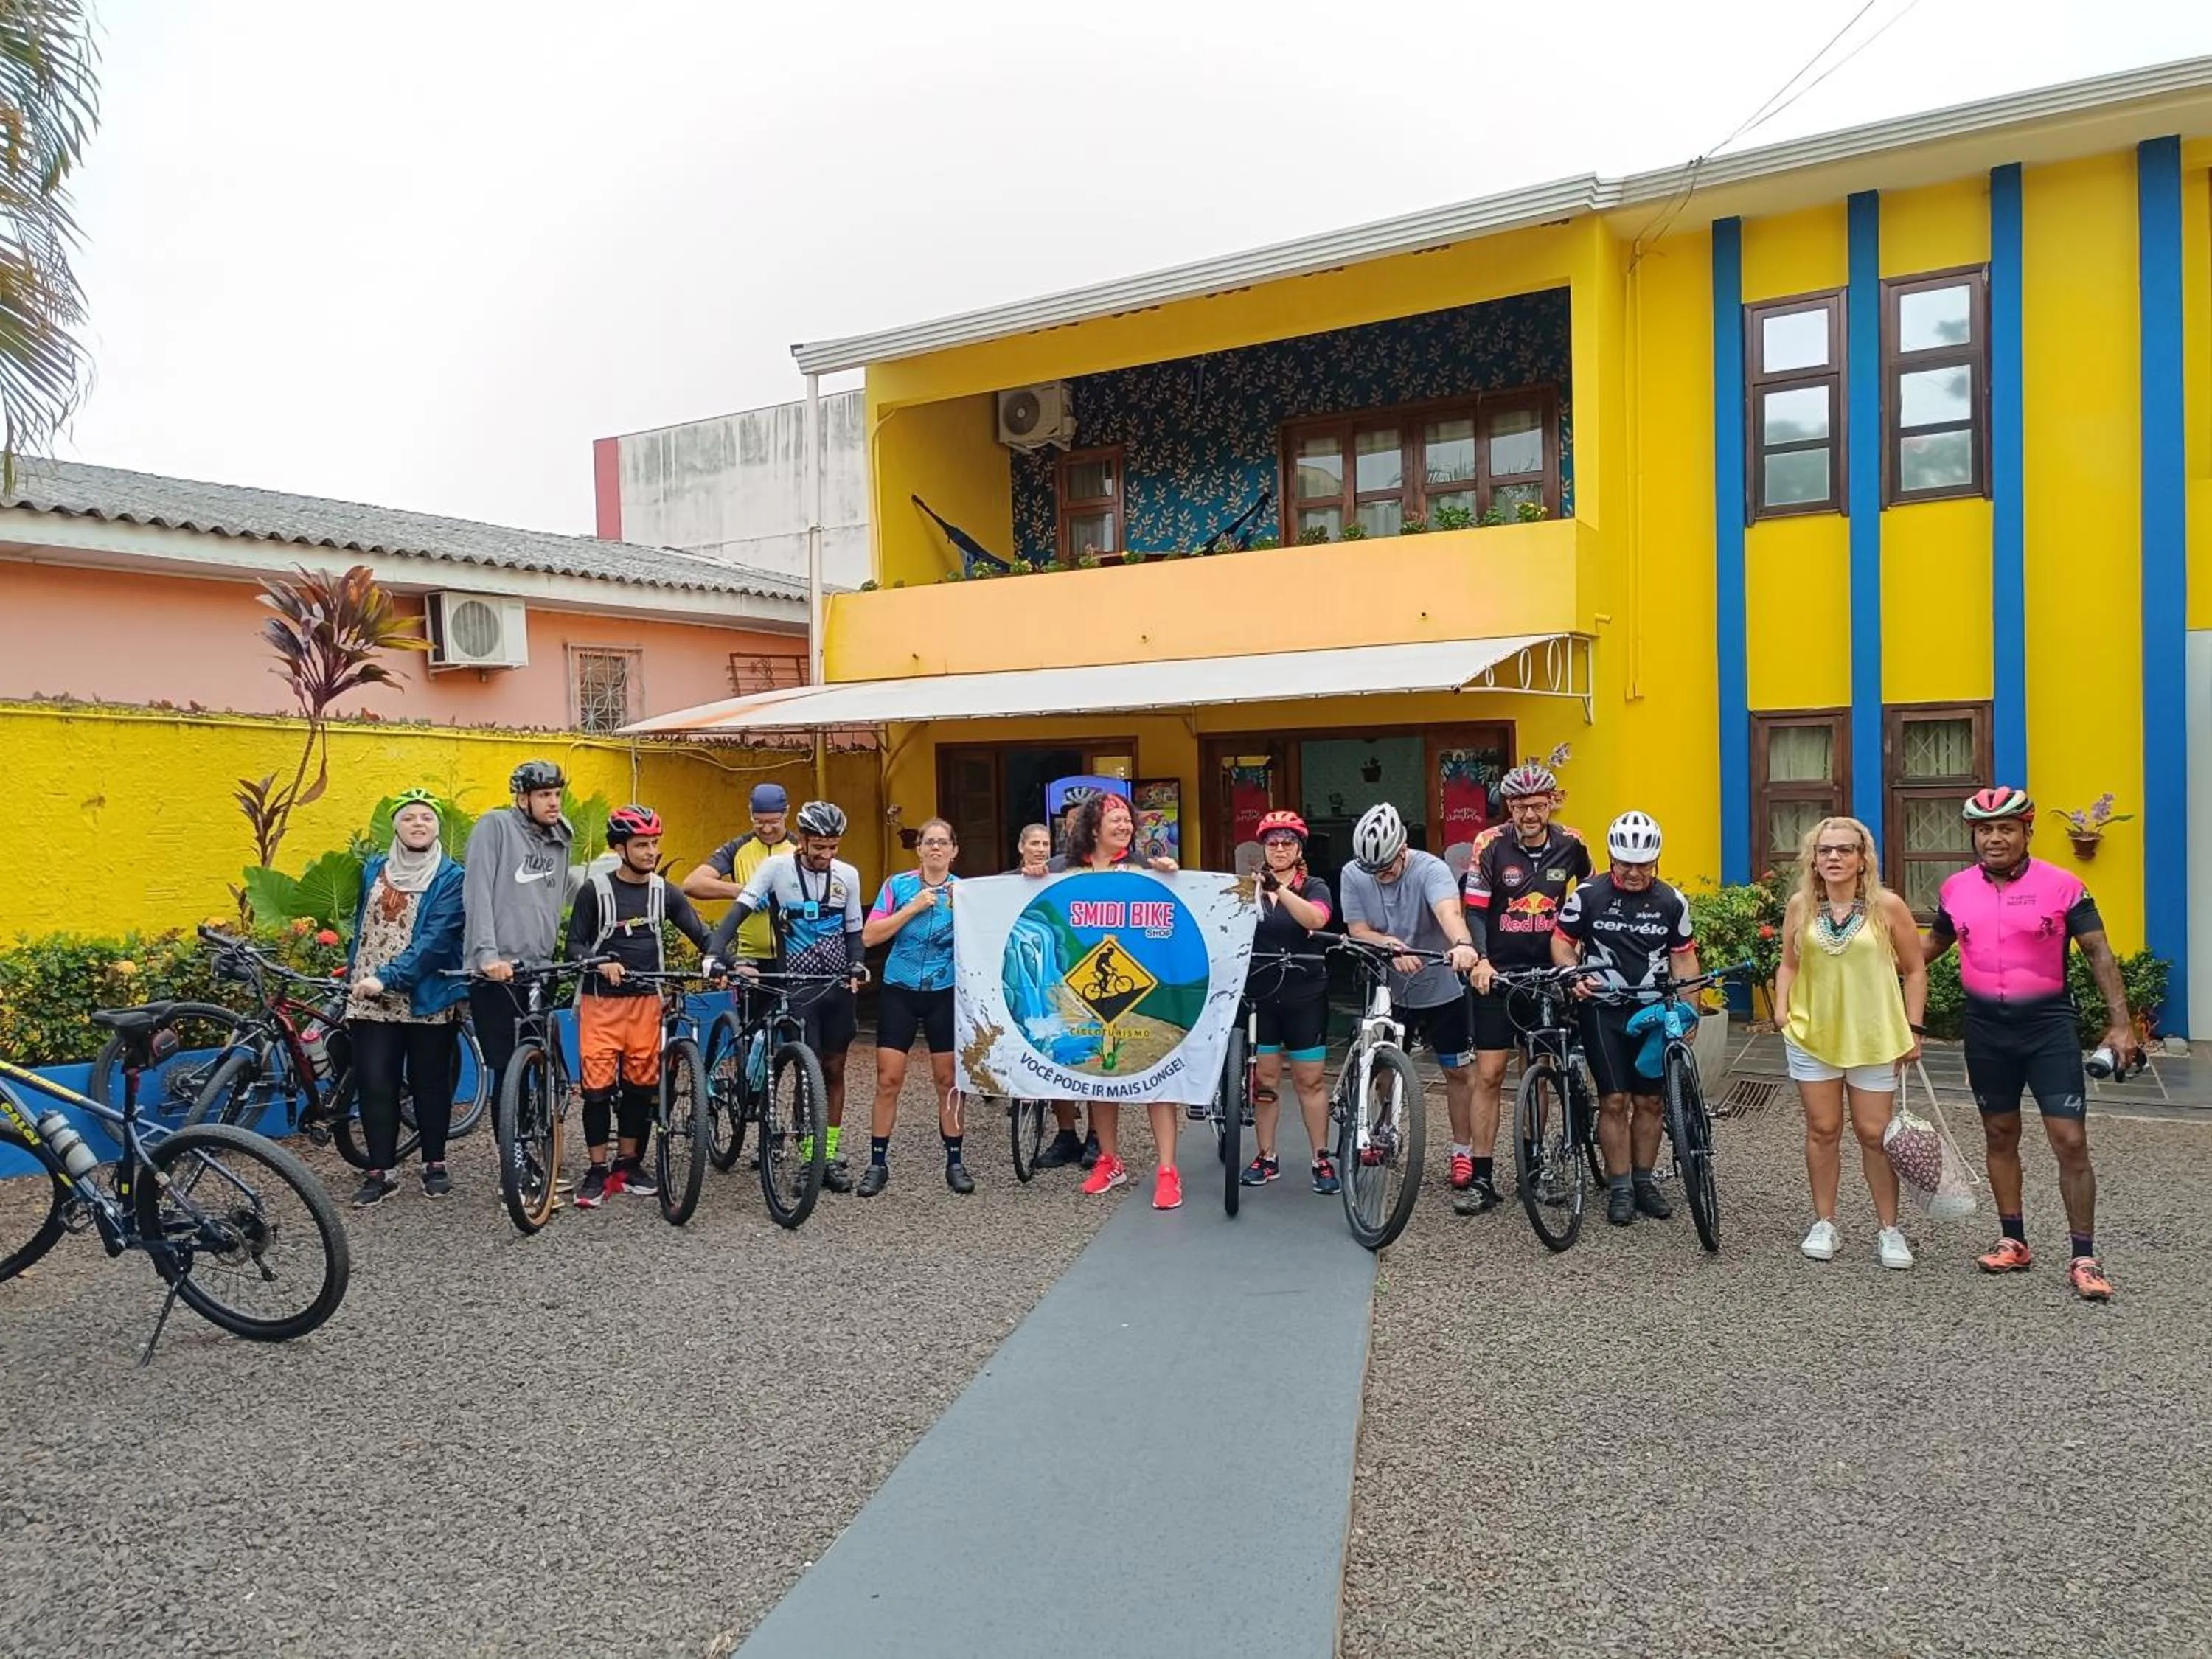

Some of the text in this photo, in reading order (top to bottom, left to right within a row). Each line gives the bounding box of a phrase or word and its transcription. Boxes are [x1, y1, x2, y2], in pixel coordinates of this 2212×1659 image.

[1071, 901, 1174, 929] SMIDI BIKE
[1500, 914, 1533, 932] Red
[1146, 929, 1172, 938] SHOP
[1020, 1051, 1186, 1098] VOCÊ PODE IR MAIS LONGE!
